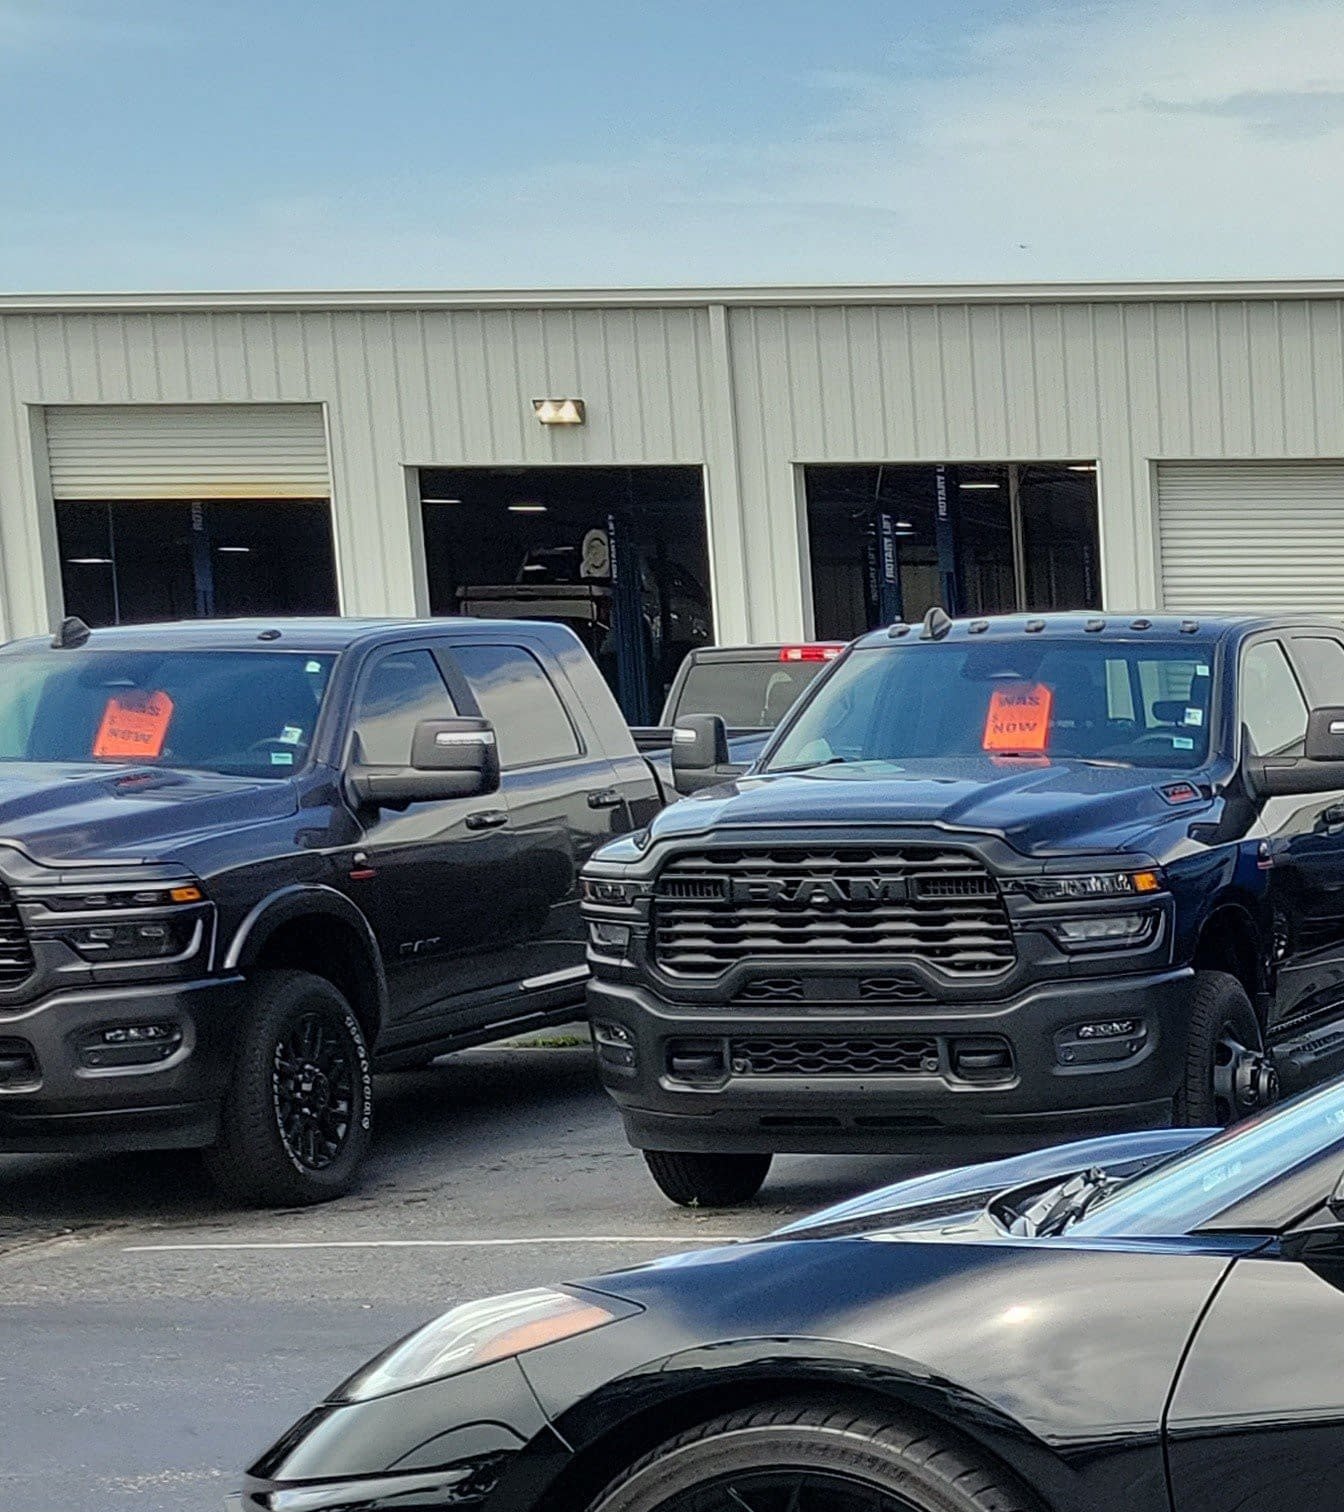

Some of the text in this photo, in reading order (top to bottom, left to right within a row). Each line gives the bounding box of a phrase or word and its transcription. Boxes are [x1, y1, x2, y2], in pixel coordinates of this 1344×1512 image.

[882, 514, 895, 579] ROTARY LIFT
[993, 722, 1038, 734] NOW
[732, 877, 906, 902] RAM
